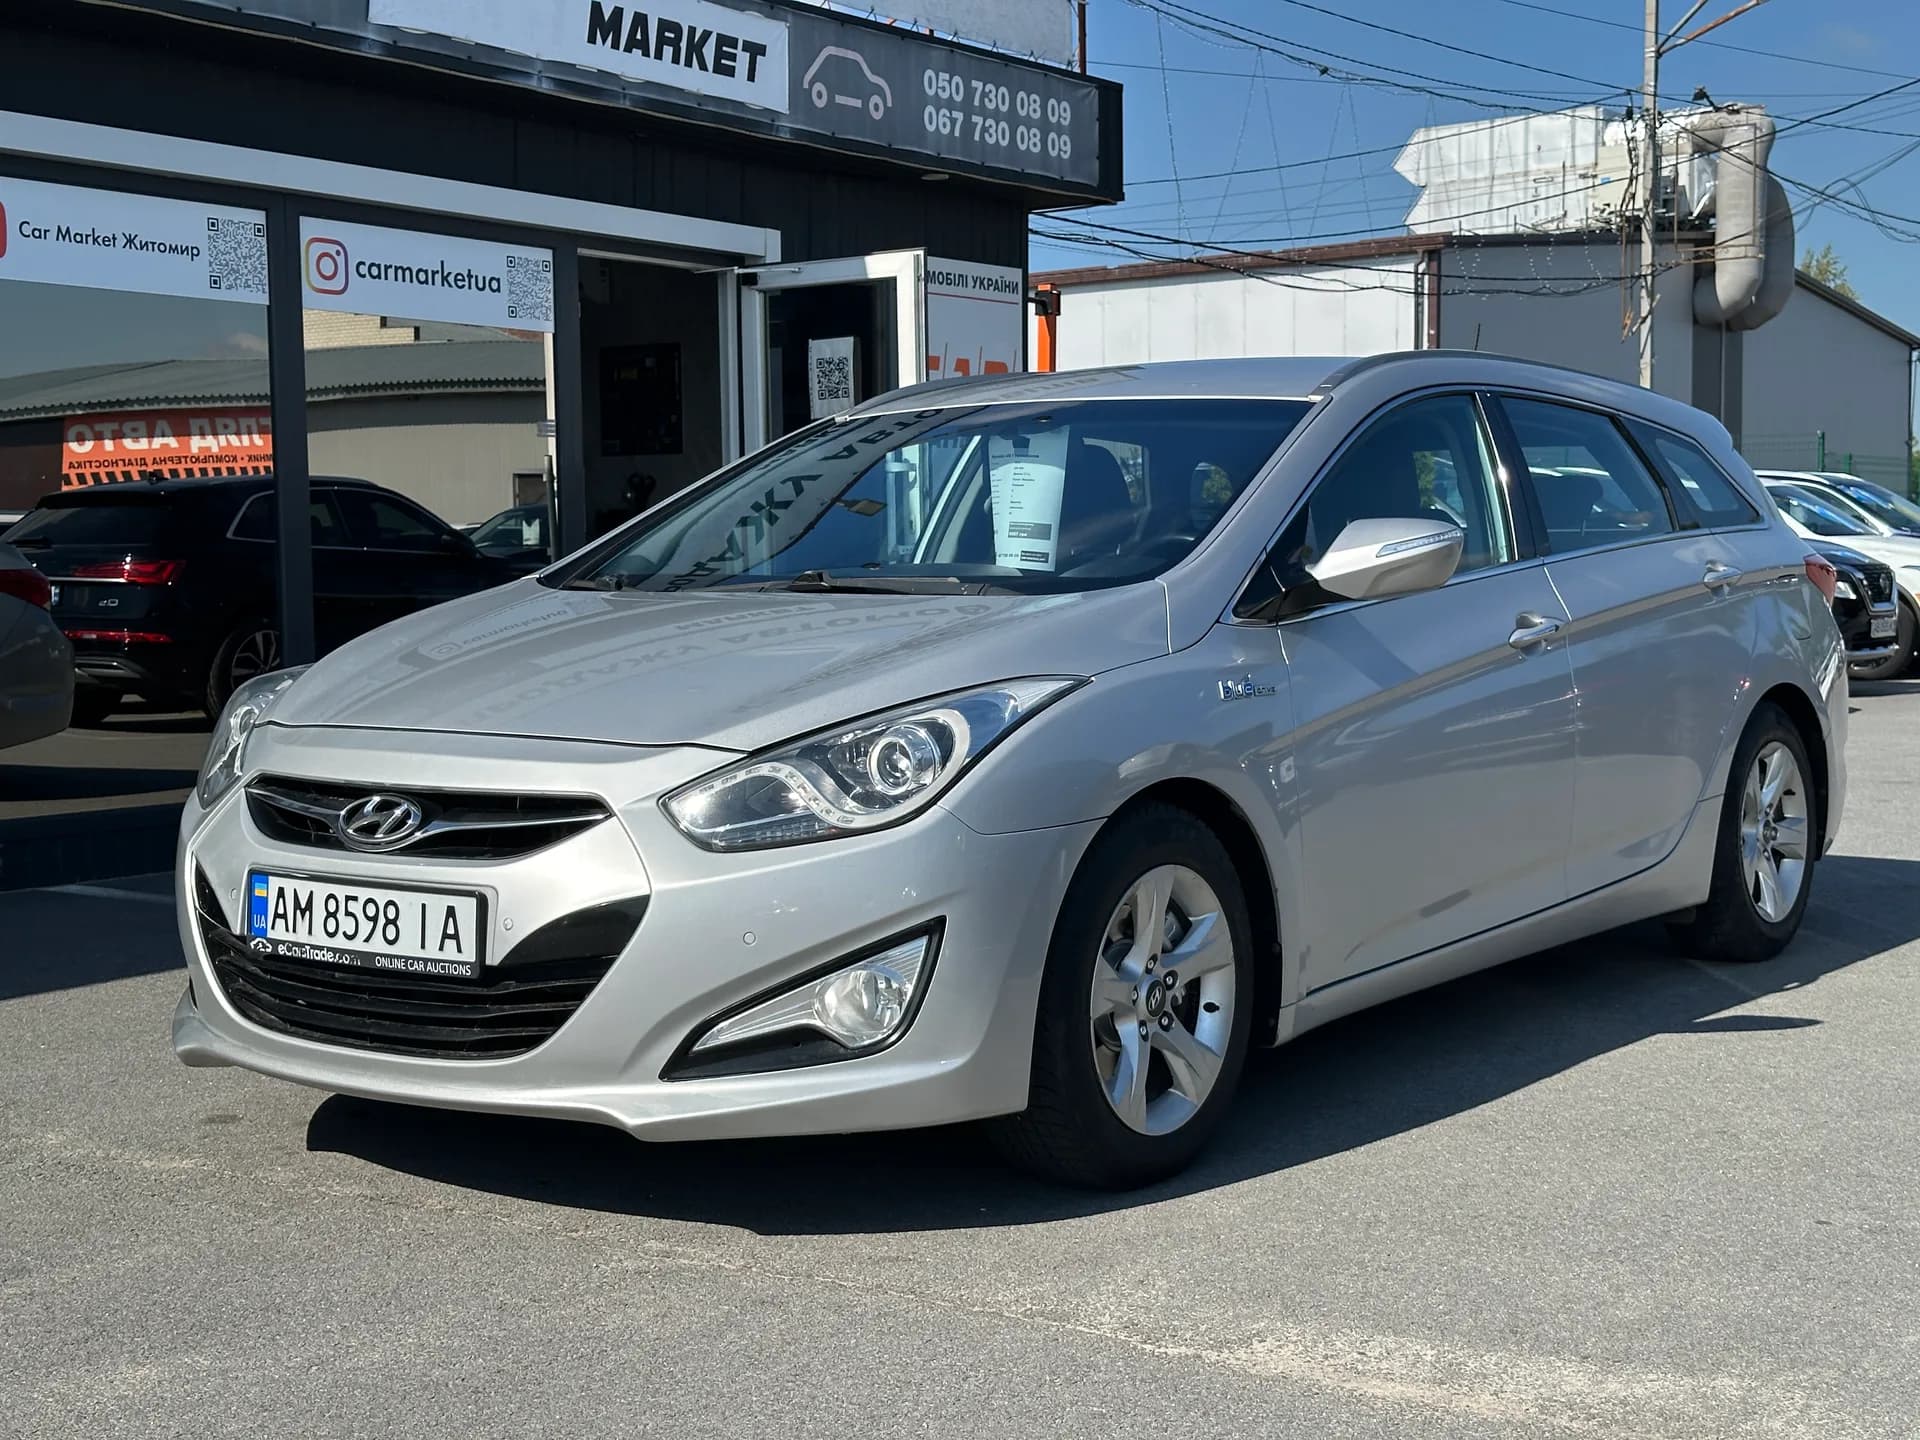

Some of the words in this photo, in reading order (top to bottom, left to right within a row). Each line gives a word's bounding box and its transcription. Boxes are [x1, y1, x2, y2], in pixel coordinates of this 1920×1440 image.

[587, 0, 767, 83] MARKET
[923, 69, 964, 102] 050
[971, 79, 1010, 112] 730
[1016, 91, 1041, 119] 08
[1047, 98, 1071, 126] 09
[923, 105, 964, 137] 067
[971, 115, 1010, 146] 730
[1016, 125, 1041, 153] 08
[1047, 132, 1071, 159] 09
[18, 221, 50, 241] Car
[56, 225, 118, 248] Market
[122, 232, 201, 261] Житомир
[355, 260, 501, 293] carmarketua
[971, 275, 1019, 295] УКРАЇНИ
[254, 914, 267, 929] UA
[271, 886, 314, 936] AM
[323, 893, 400, 946] 8598
[375, 956, 406, 970] ONLINE
[407, 959, 425, 972] CAR
[426, 962, 472, 976] AUCTIONS
